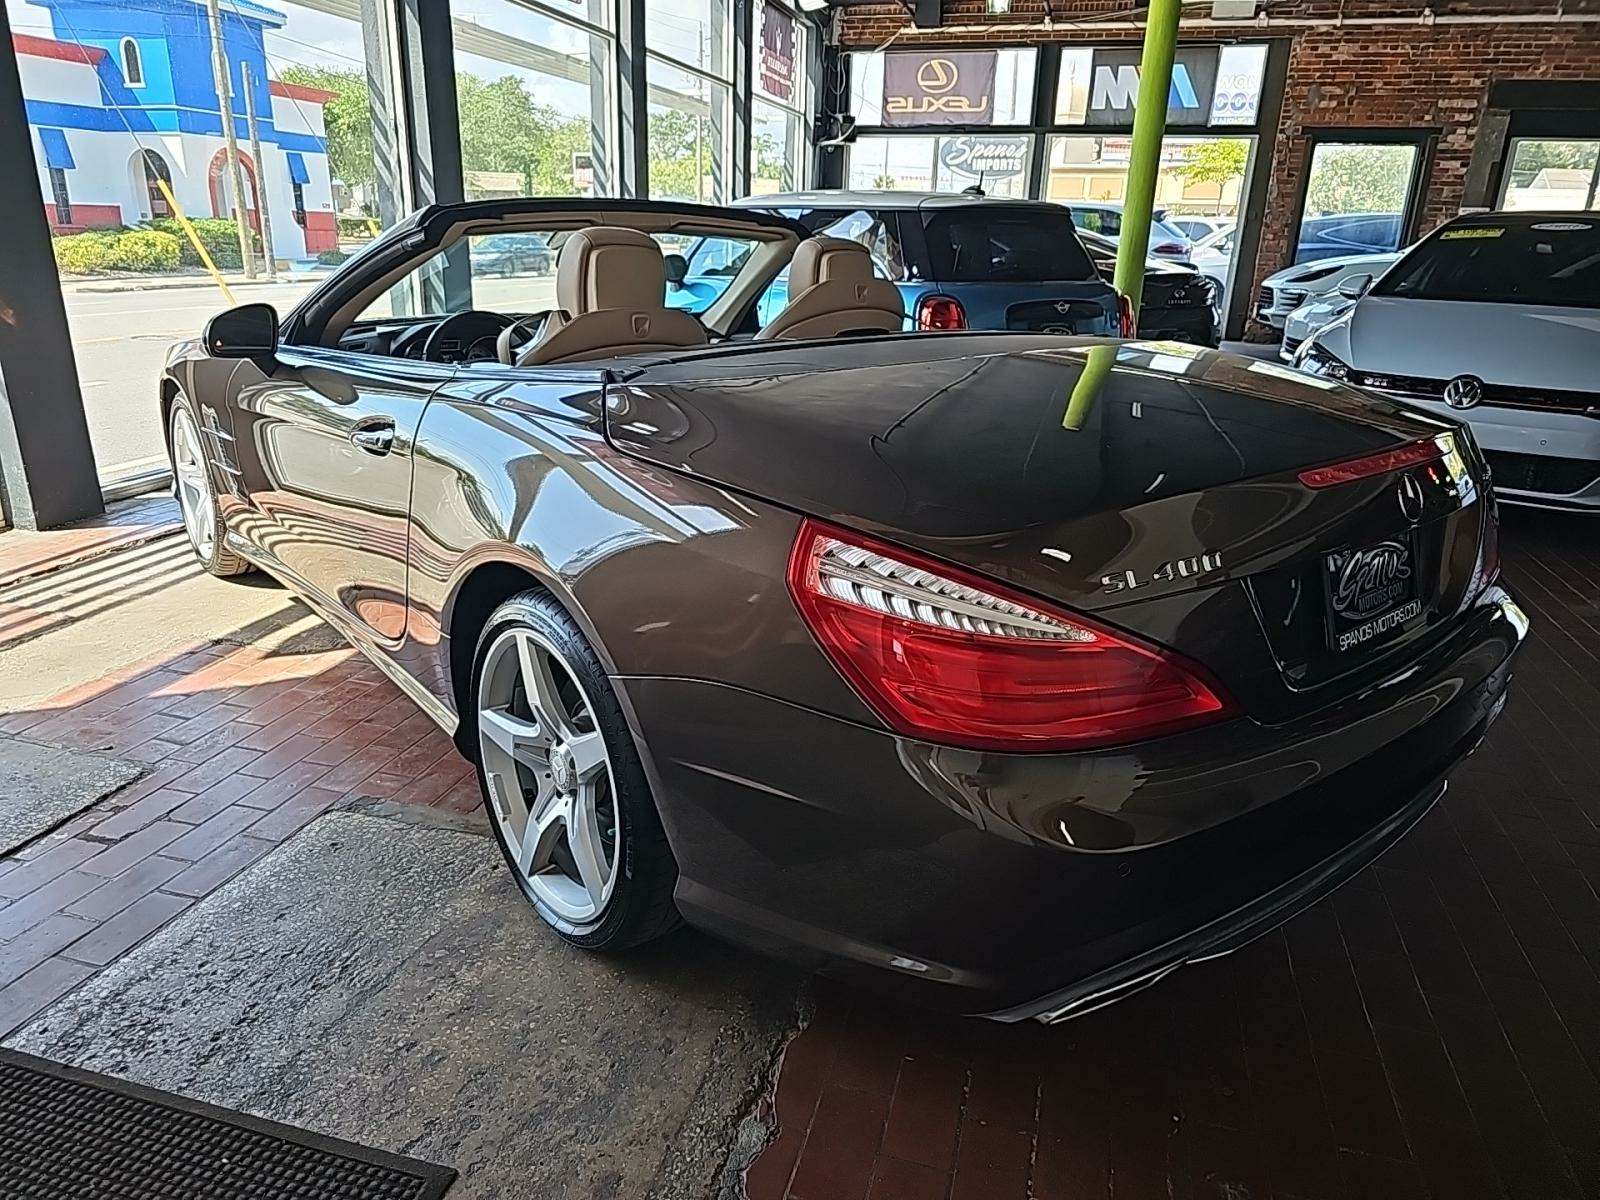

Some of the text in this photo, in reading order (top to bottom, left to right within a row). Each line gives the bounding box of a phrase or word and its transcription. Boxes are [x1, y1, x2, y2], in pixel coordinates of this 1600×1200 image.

[971, 158, 1022, 171] IMPORTS
[1101, 551, 1222, 594] SL 400
[1339, 599, 1422, 652] SPANOS MOTORS.COM
